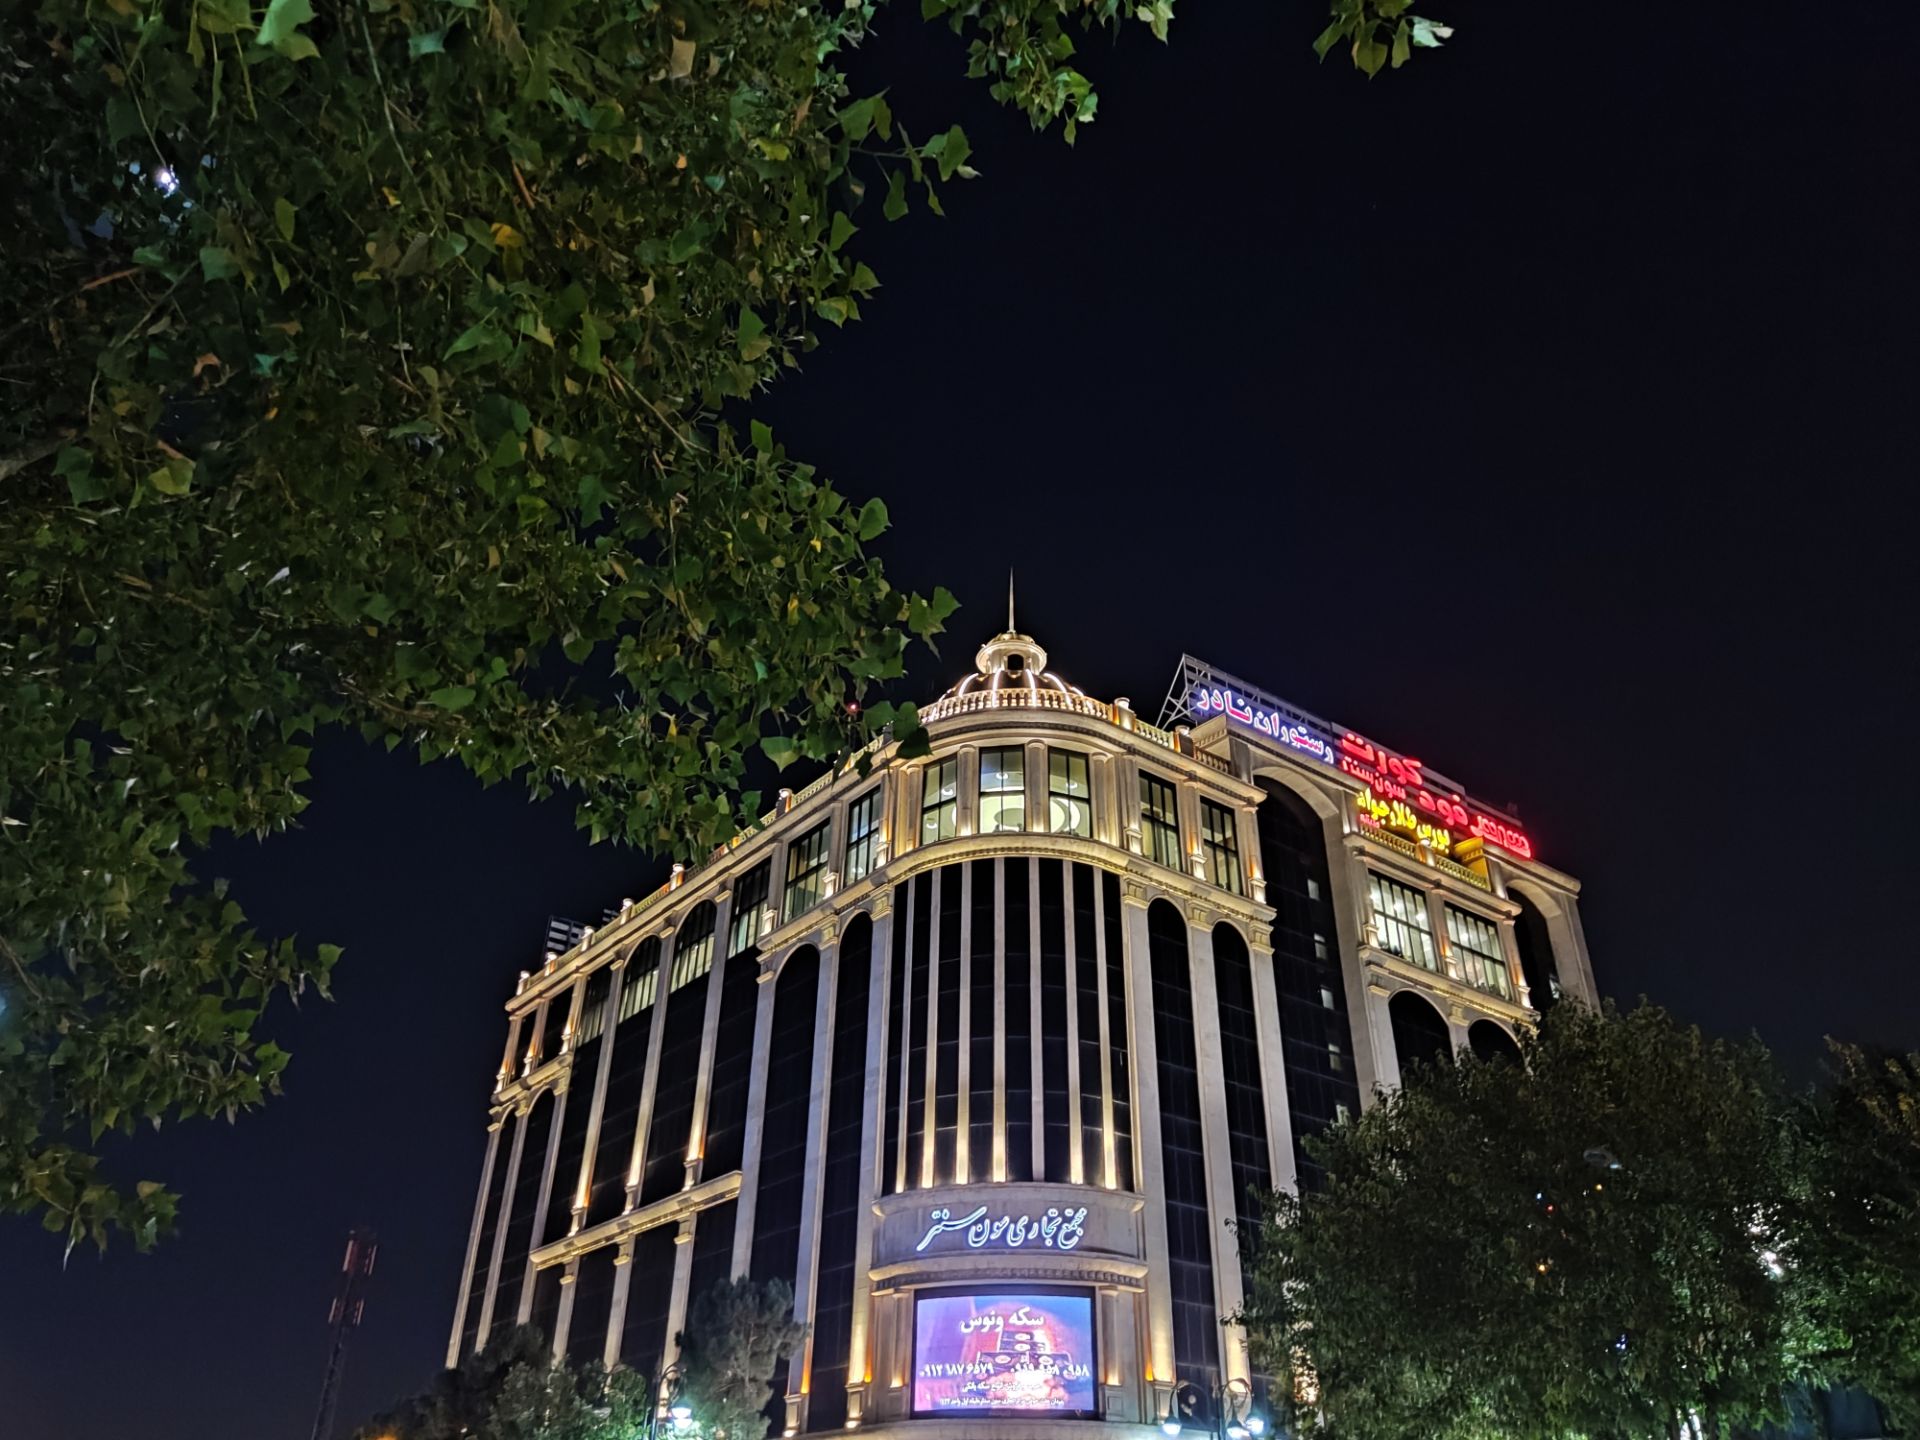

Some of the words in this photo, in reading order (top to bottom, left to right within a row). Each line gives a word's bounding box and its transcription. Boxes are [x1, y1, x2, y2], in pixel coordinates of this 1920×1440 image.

[1197, 689, 1253, 724] نادر
[1253, 711, 1334, 764] رستوران
[1341, 733, 1423, 785] کورت
[1374, 772, 1406, 799] سون
[1419, 790, 1469, 826] فود
[916, 1206, 988, 1251] سنتر
[968, 1215, 1010, 1248] سون
[1006, 1208, 1062, 1248] تجاری
[1058, 1207, 1087, 1250] مجتمع
[960, 1310, 1005, 1333] ونوس
[1008, 1306, 1045, 1326] سکه
